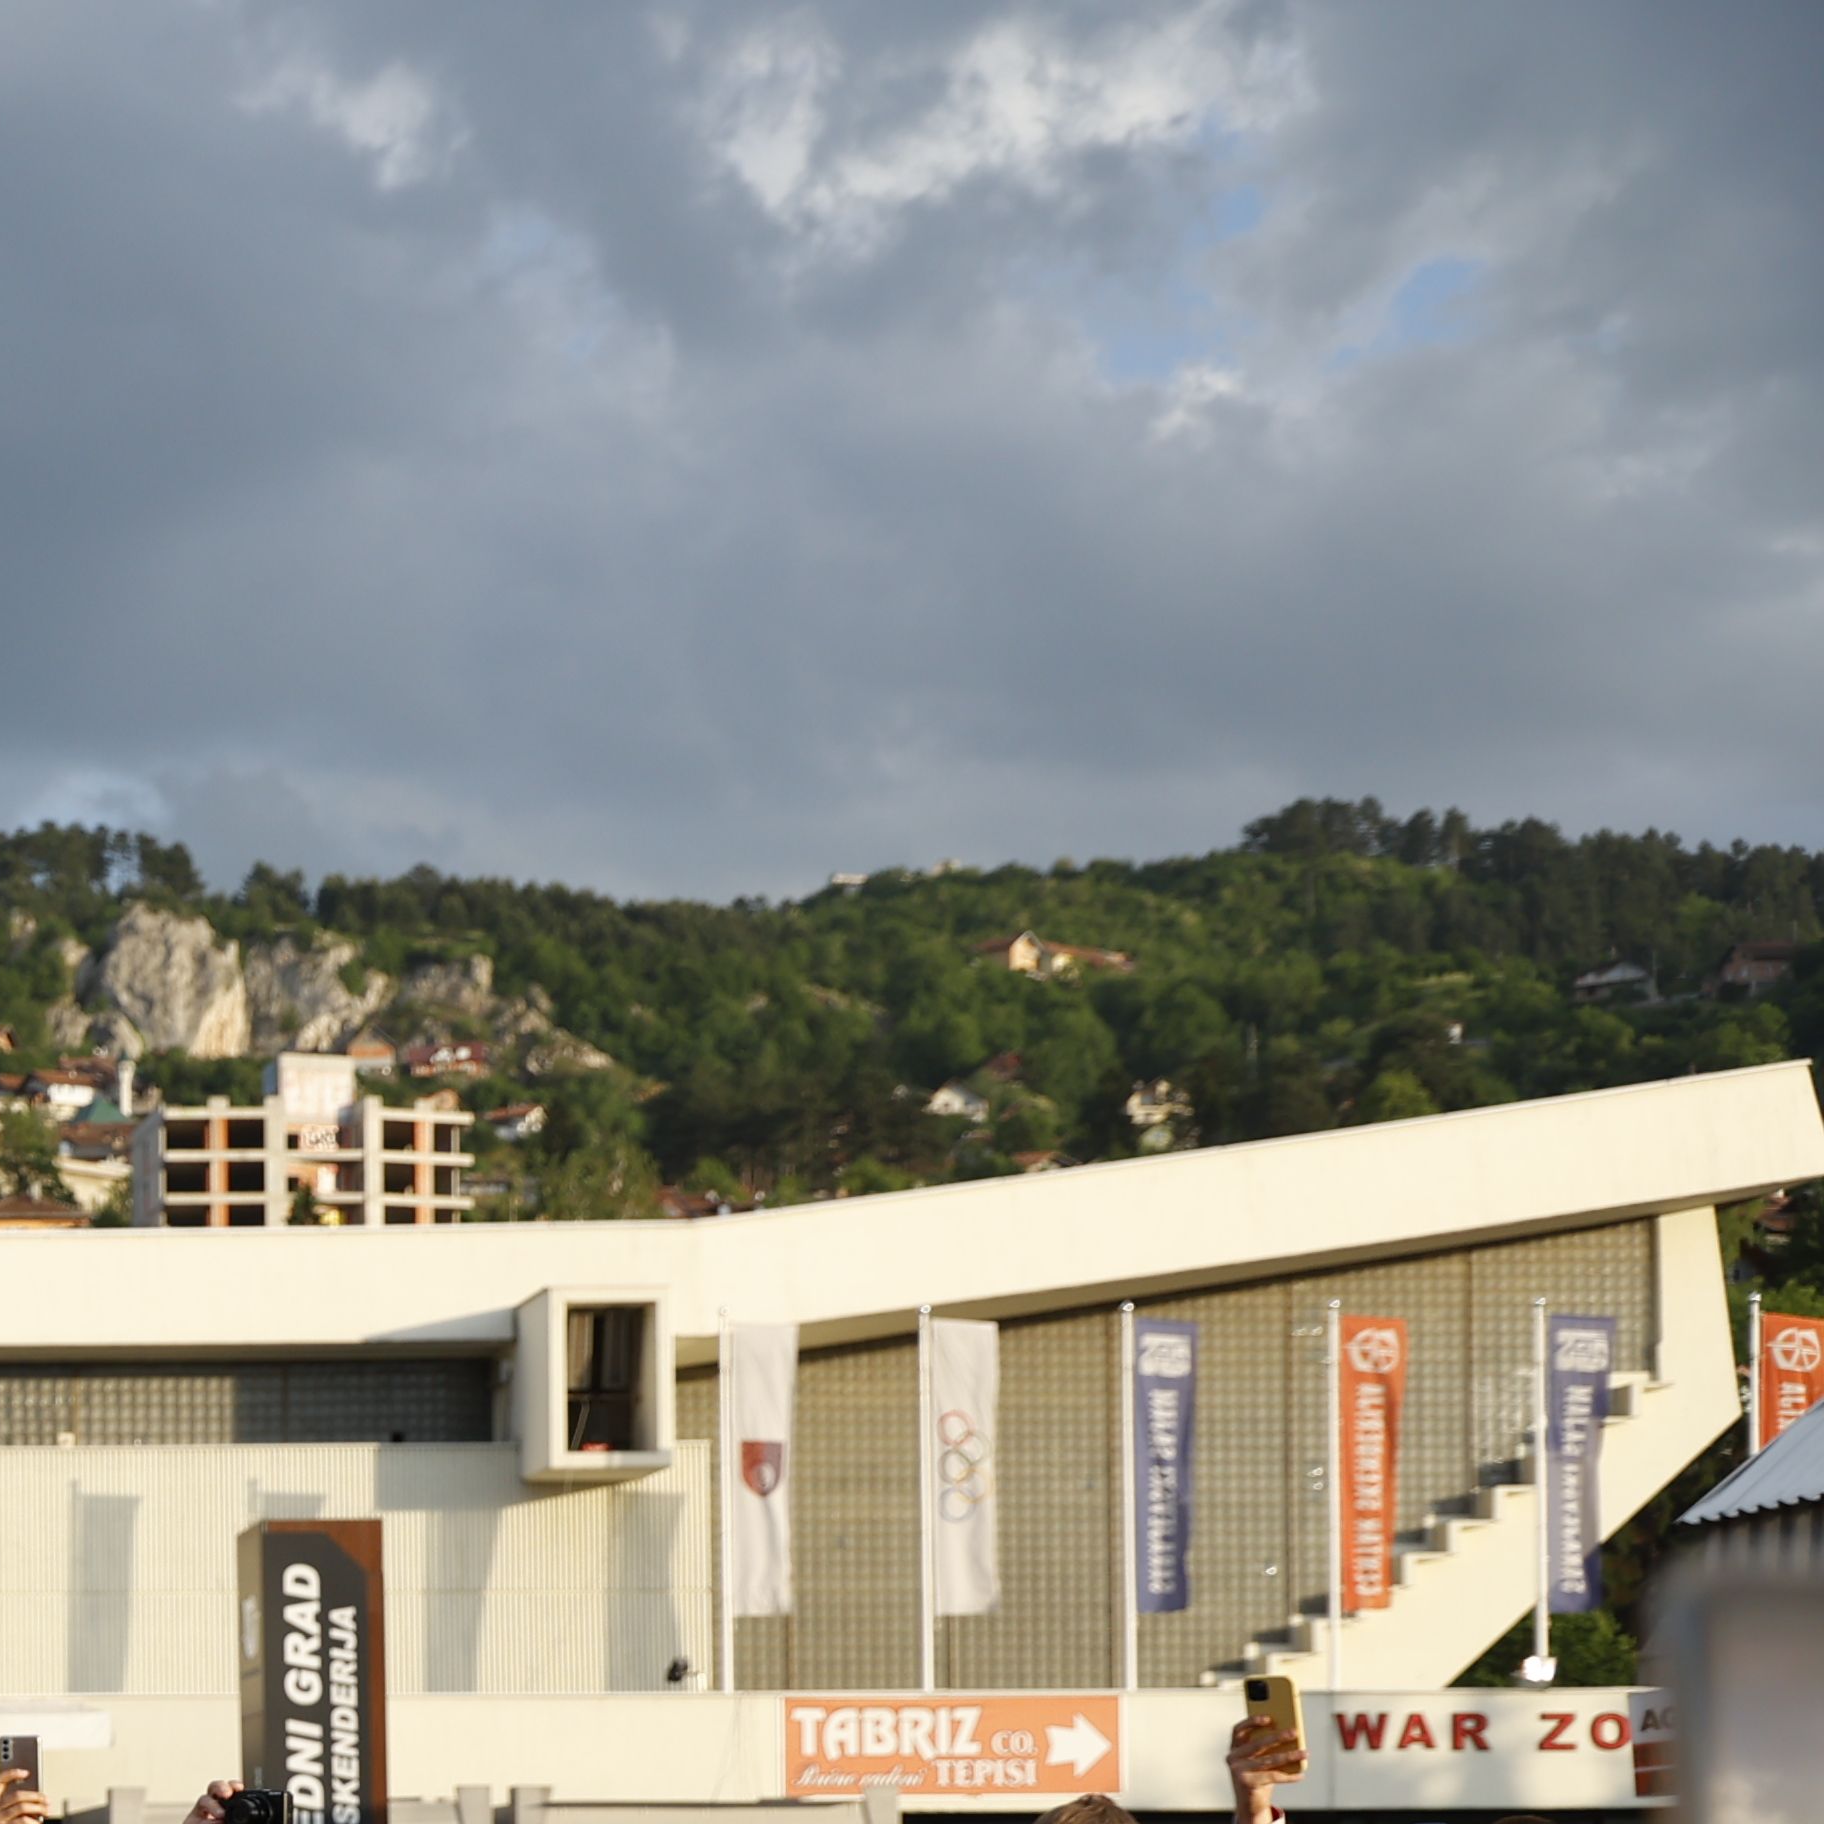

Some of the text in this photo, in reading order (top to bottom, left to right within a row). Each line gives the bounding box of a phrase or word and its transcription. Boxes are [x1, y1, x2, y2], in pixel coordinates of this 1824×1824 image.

[281, 1562, 323, 1706] GRAD
[790, 1705, 1038, 1761] TABRIZ CO.
[1335, 1712, 1490, 1751] WAR
[932, 1758, 1038, 1787] TEPISI
